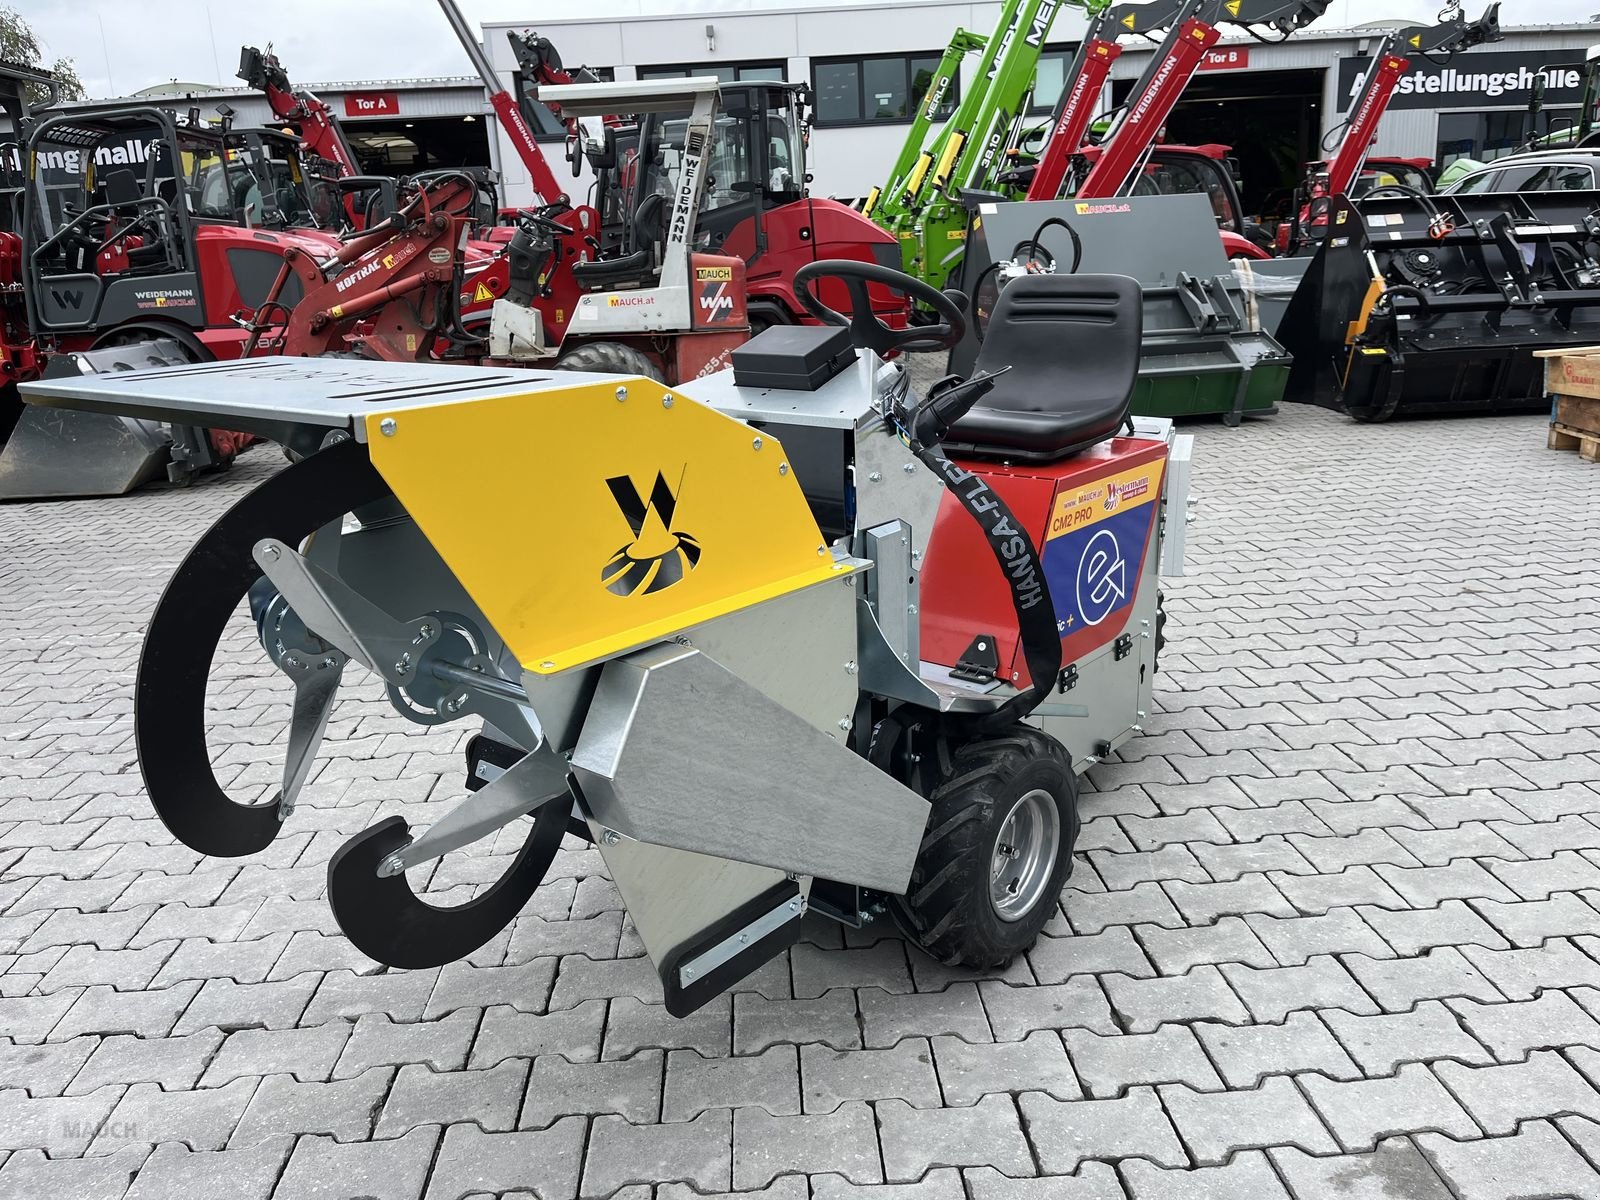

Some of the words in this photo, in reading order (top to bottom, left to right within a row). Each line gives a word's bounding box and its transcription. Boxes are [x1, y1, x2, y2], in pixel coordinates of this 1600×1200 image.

[1208, 53, 1227, 64] Tor
[1229, 51, 1238, 62] B
[355, 98, 375, 110] Tor
[378, 97, 387, 109] A
[925, 76, 949, 121] MERLO
[1057, 73, 1088, 134] WEIDEMANN
[1129, 55, 1177, 123] WEIDEMANN
[1351, 82, 1380, 134] WEIDEMANN
[509, 108, 536, 152] WEIDEMANN
[981, 133, 1001, 169] 38.10
[672, 158, 699, 243] WEIDEMANN
[698, 268, 730, 279] MAUCH
[135, 289, 193, 299] WEIDEMANN
[609, 296, 655, 307] MAUCH.at
[1053, 514, 1073, 532] CM2
[1074, 506, 1093, 524] PRO
